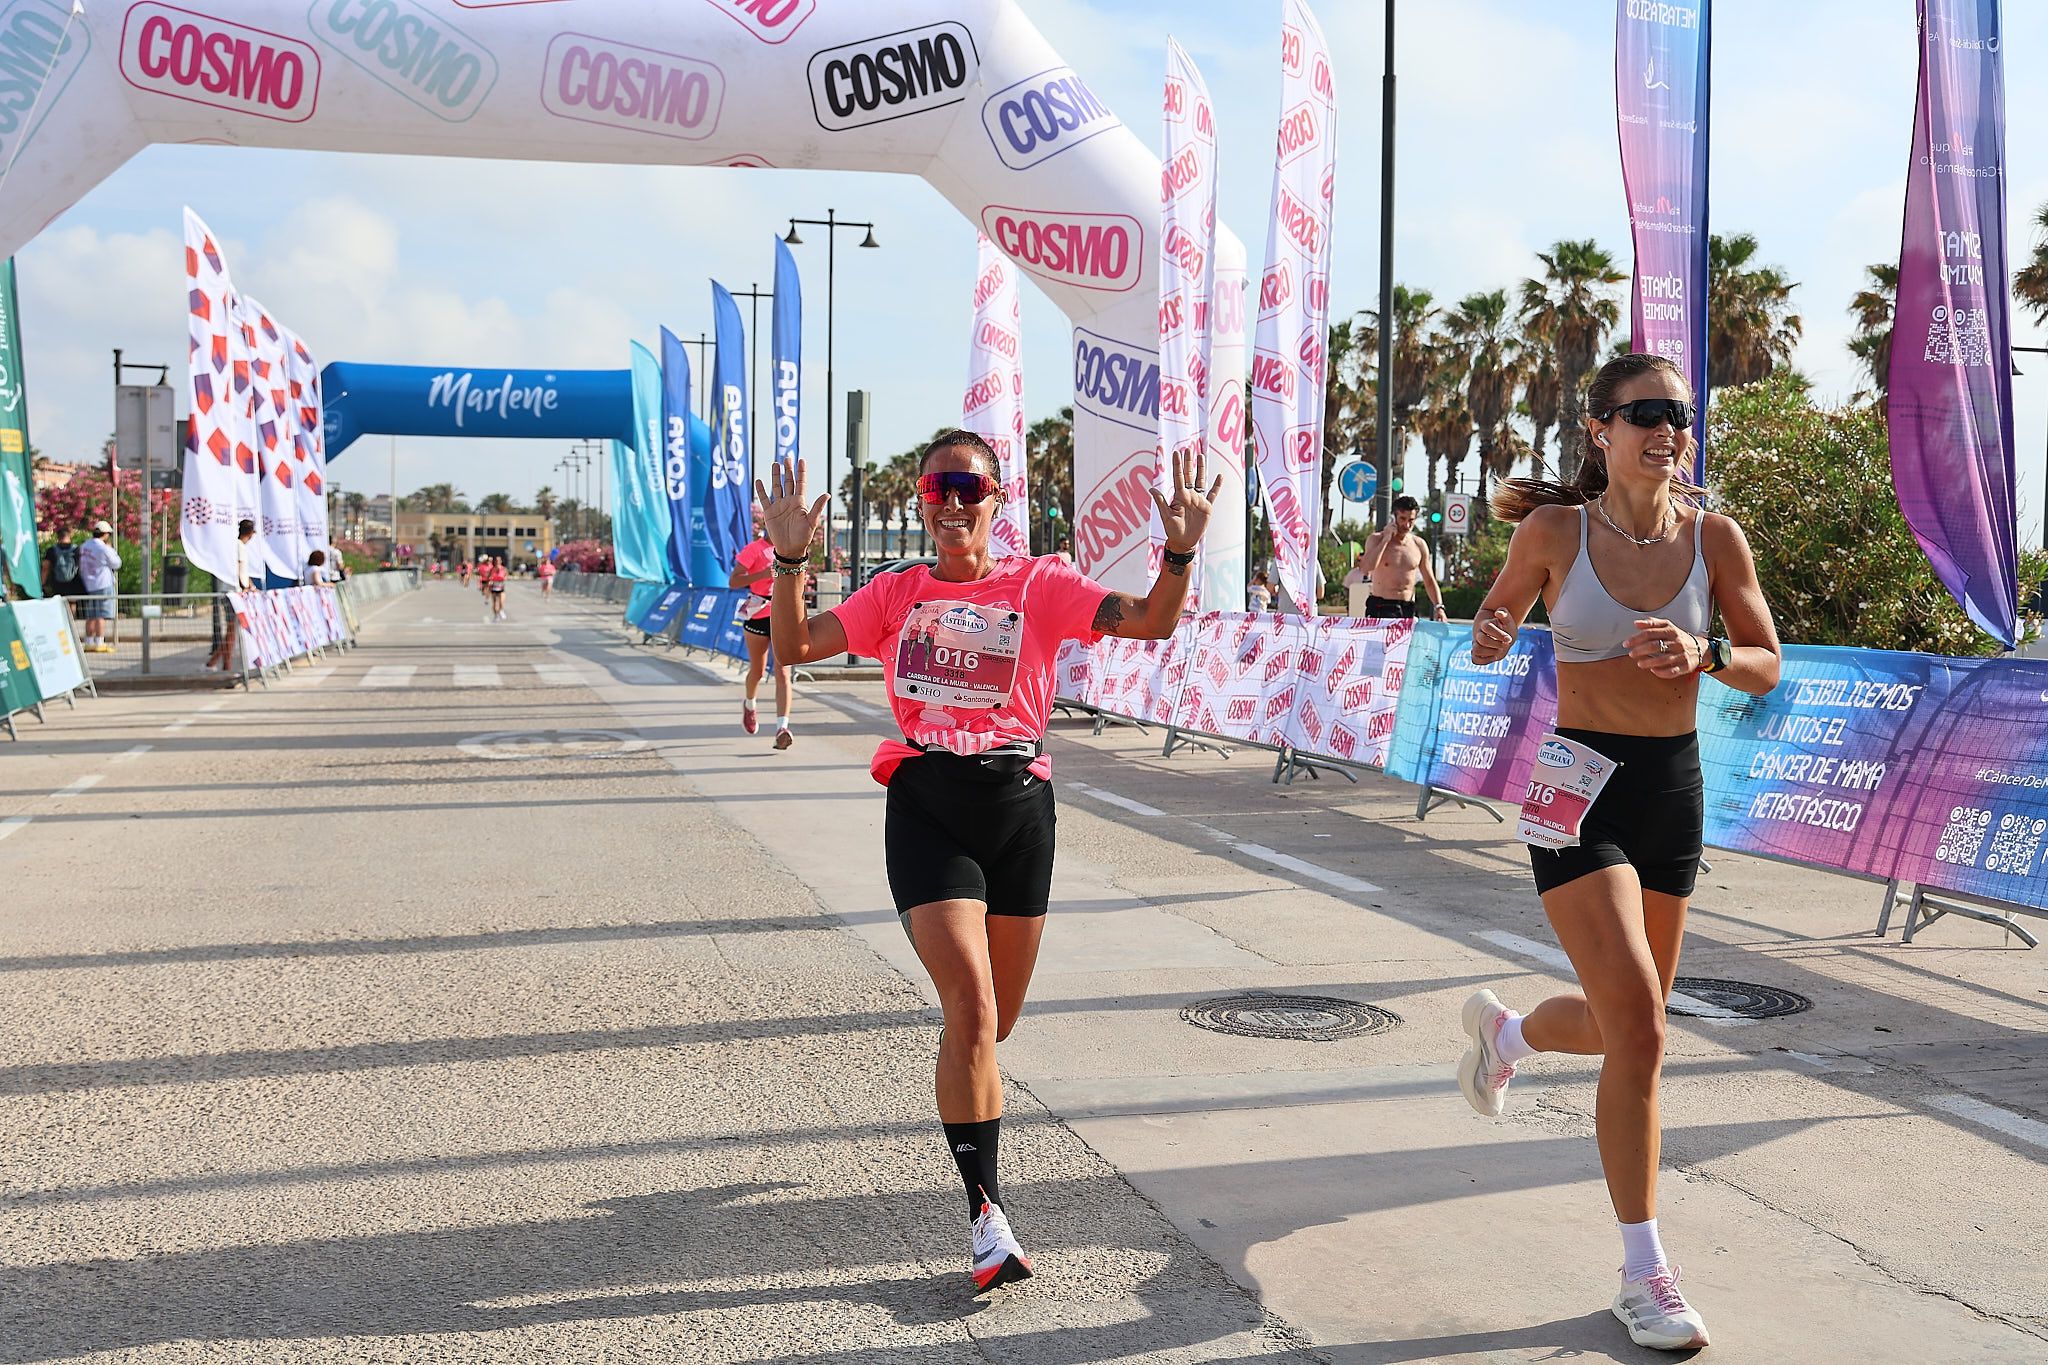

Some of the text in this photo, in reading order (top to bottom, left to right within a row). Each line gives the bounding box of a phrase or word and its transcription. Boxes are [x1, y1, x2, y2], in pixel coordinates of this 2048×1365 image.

[138, 15, 302, 110] COSMO
[825, 33, 966, 117] COSMO
[558, 43, 709, 131] COSMO
[995, 216, 1129, 279] COSMO
[428, 372, 559, 428] Marlene
[943, 614, 985, 630] ASTURIANA
[935, 648, 979, 670] 016
[1240, 636, 1264, 676] COSMO
[1265, 650, 1290, 681] COSMO
[1297, 648, 1323, 677] COSMO
[1327, 645, 1354, 694] COSMO
[907, 671, 932, 683] CARRERA
[932, 676, 941, 684] DE
[949, 679, 969, 689] MUJER
[973, 682, 999, 692] VALENCIA
[944, 668, 965, 679] 3318
[963, 695, 996, 704] Santander
[1228, 699, 1257, 720] COSMO
[1267, 687, 1294, 720] COSMO
[1344, 681, 1372, 710] COSMO
[1484, 683, 1498, 706] EL
[1784, 678, 1923, 712] VISIBILICEMOS
[1300, 698, 1323, 744] COSMO
[1757, 715, 1848, 746] JUNTOS EL
[1330, 723, 1356, 760] COSMO
[1749, 746, 1887, 791] CÁNCER DE MAMA
[1525, 781, 1557, 806] 016
[1543, 818, 1566, 833] VALENCIA
[1748, 791, 1862, 832] METASTÁSICO
[1531, 830, 1565, 845] Santander
